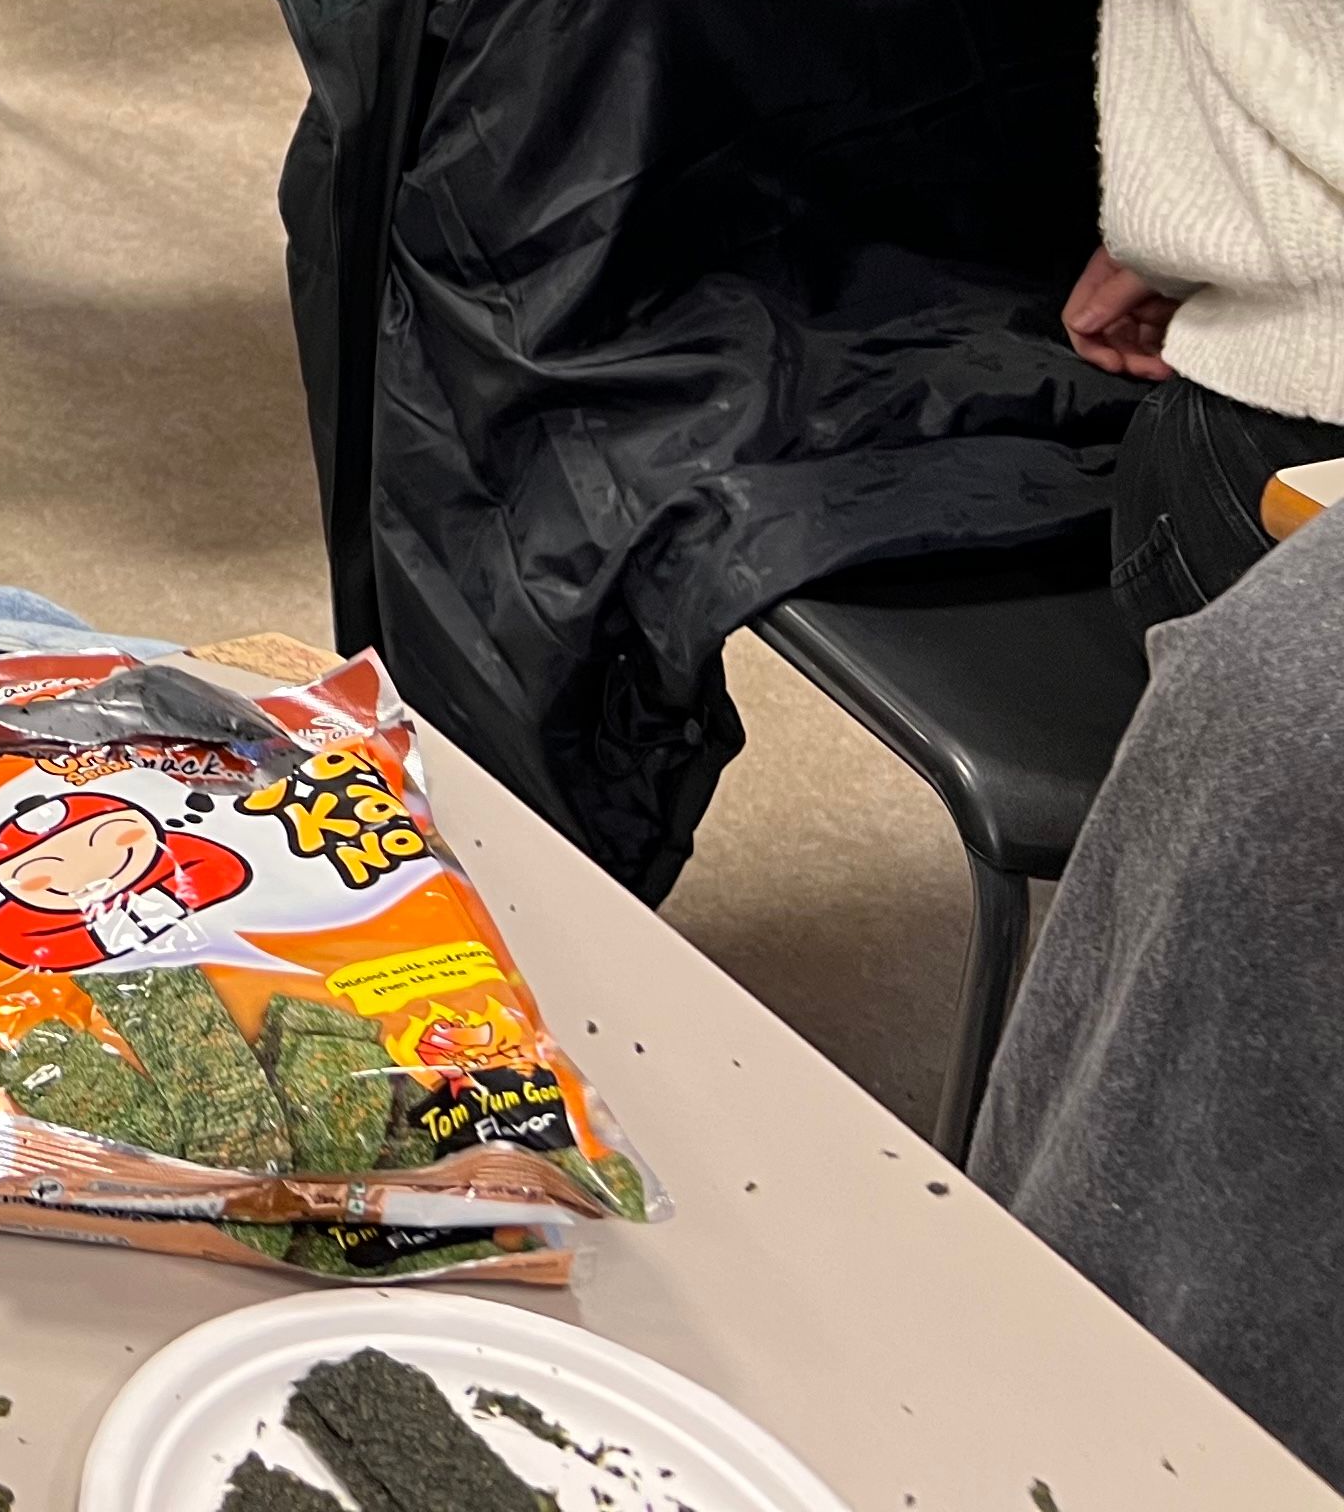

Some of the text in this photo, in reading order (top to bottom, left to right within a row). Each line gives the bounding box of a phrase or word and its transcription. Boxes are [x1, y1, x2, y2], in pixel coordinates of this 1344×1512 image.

[284, 784, 410, 852] Ka
[335, 829, 424, 884] No
[409, 973, 436, 984] the
[420, 1081, 561, 1143] Tom Yum Goo
